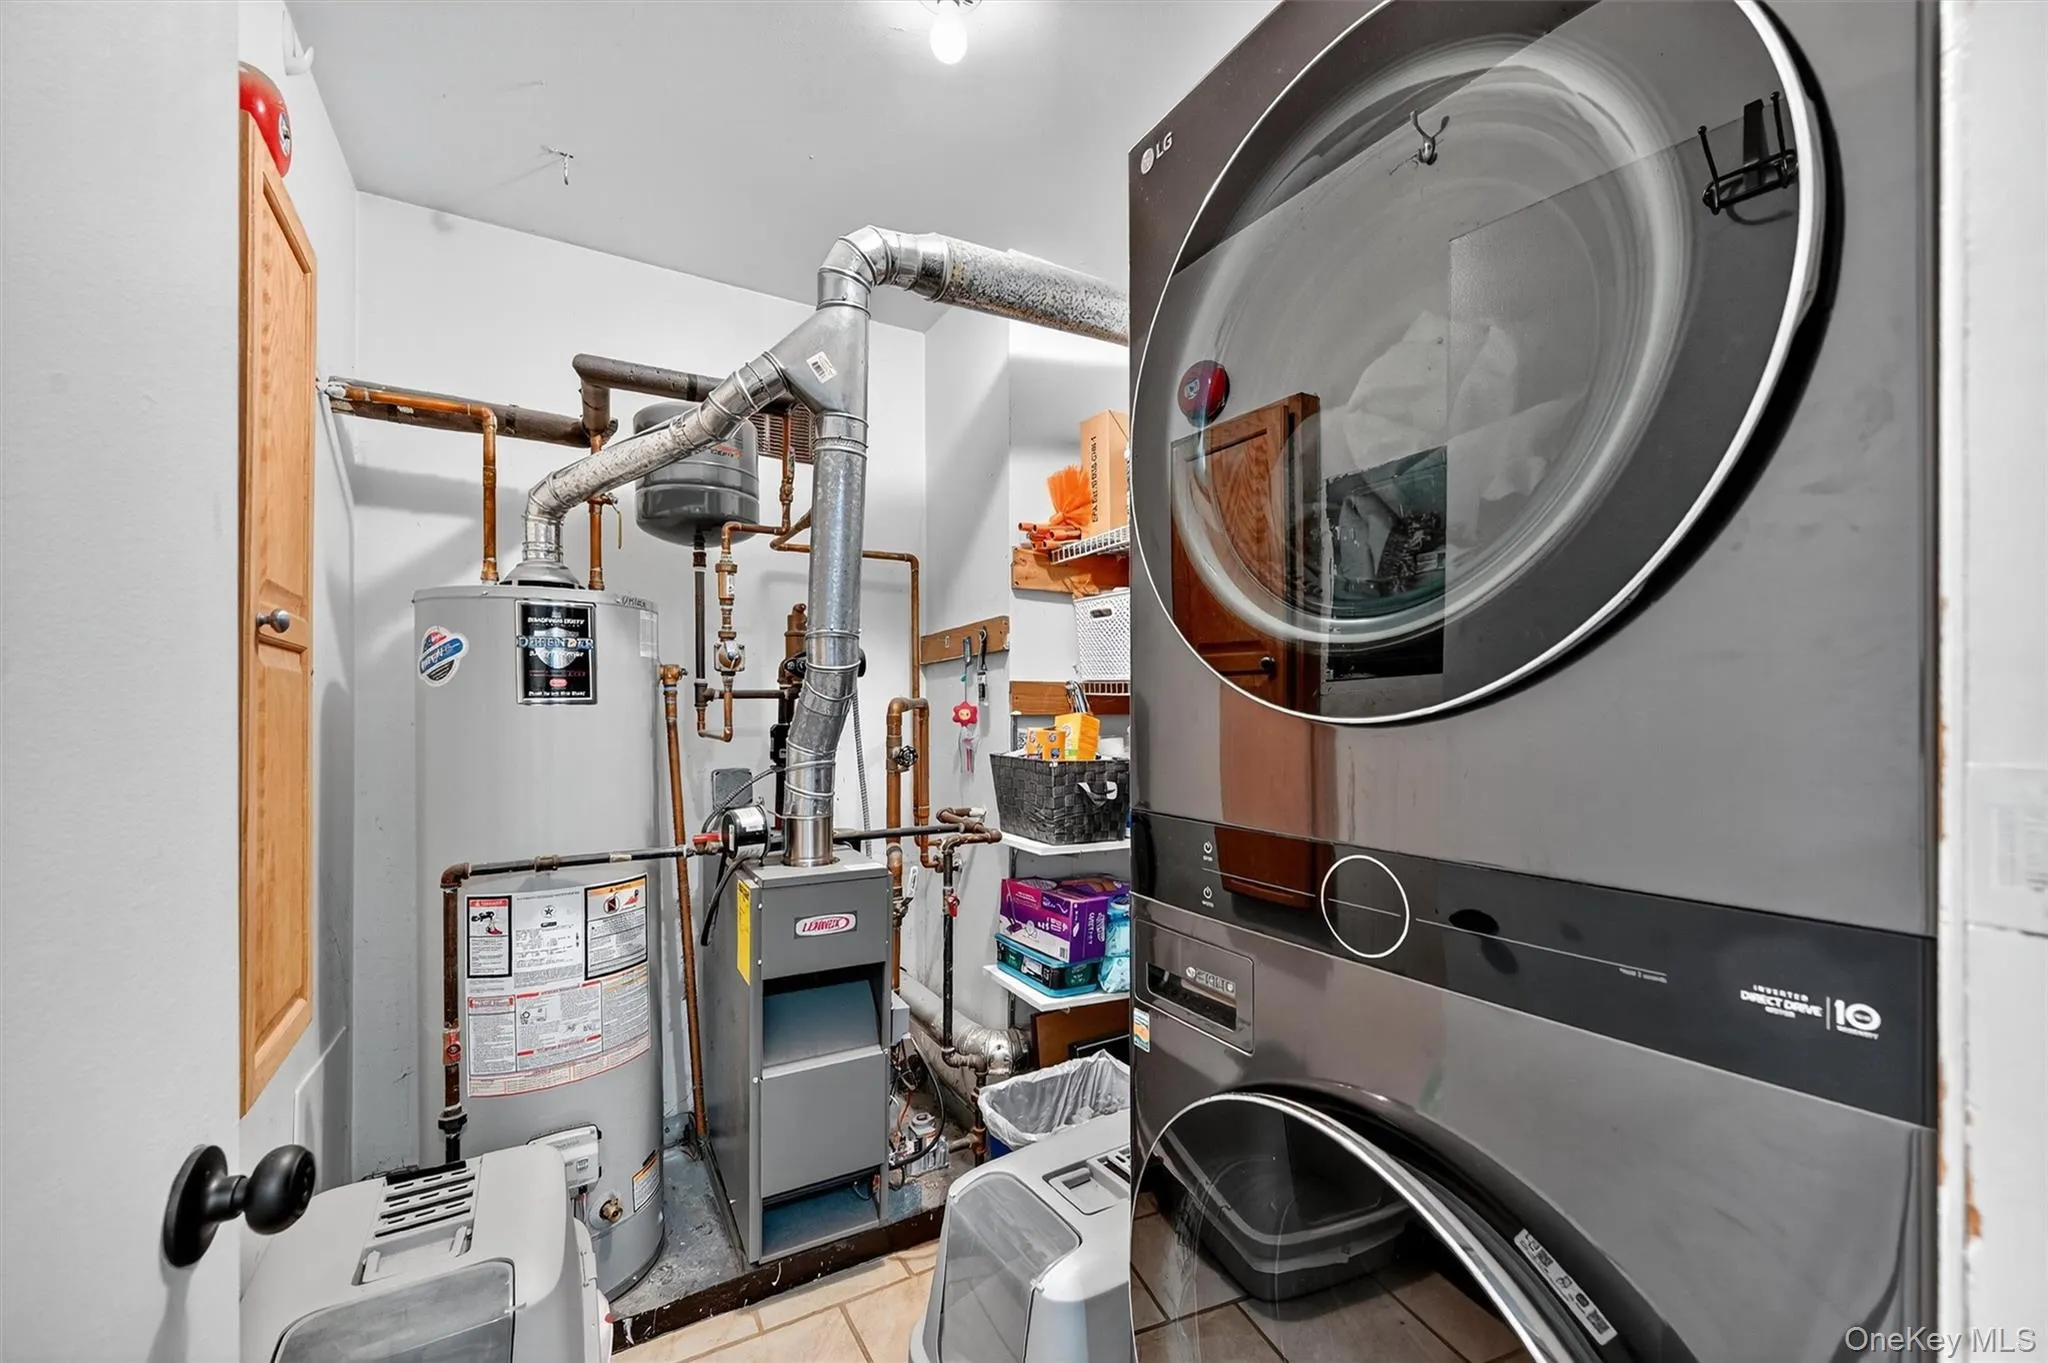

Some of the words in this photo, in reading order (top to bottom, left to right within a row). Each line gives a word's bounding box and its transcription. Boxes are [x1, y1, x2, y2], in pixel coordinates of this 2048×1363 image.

[1156, 131, 1173, 159] LG
[802, 916, 850, 932] LENNOX
[1740, 990, 1783, 1008] DIRECT
[1783, 999, 1824, 1018] DRIVE
[1834, 998, 1882, 1031] 10
